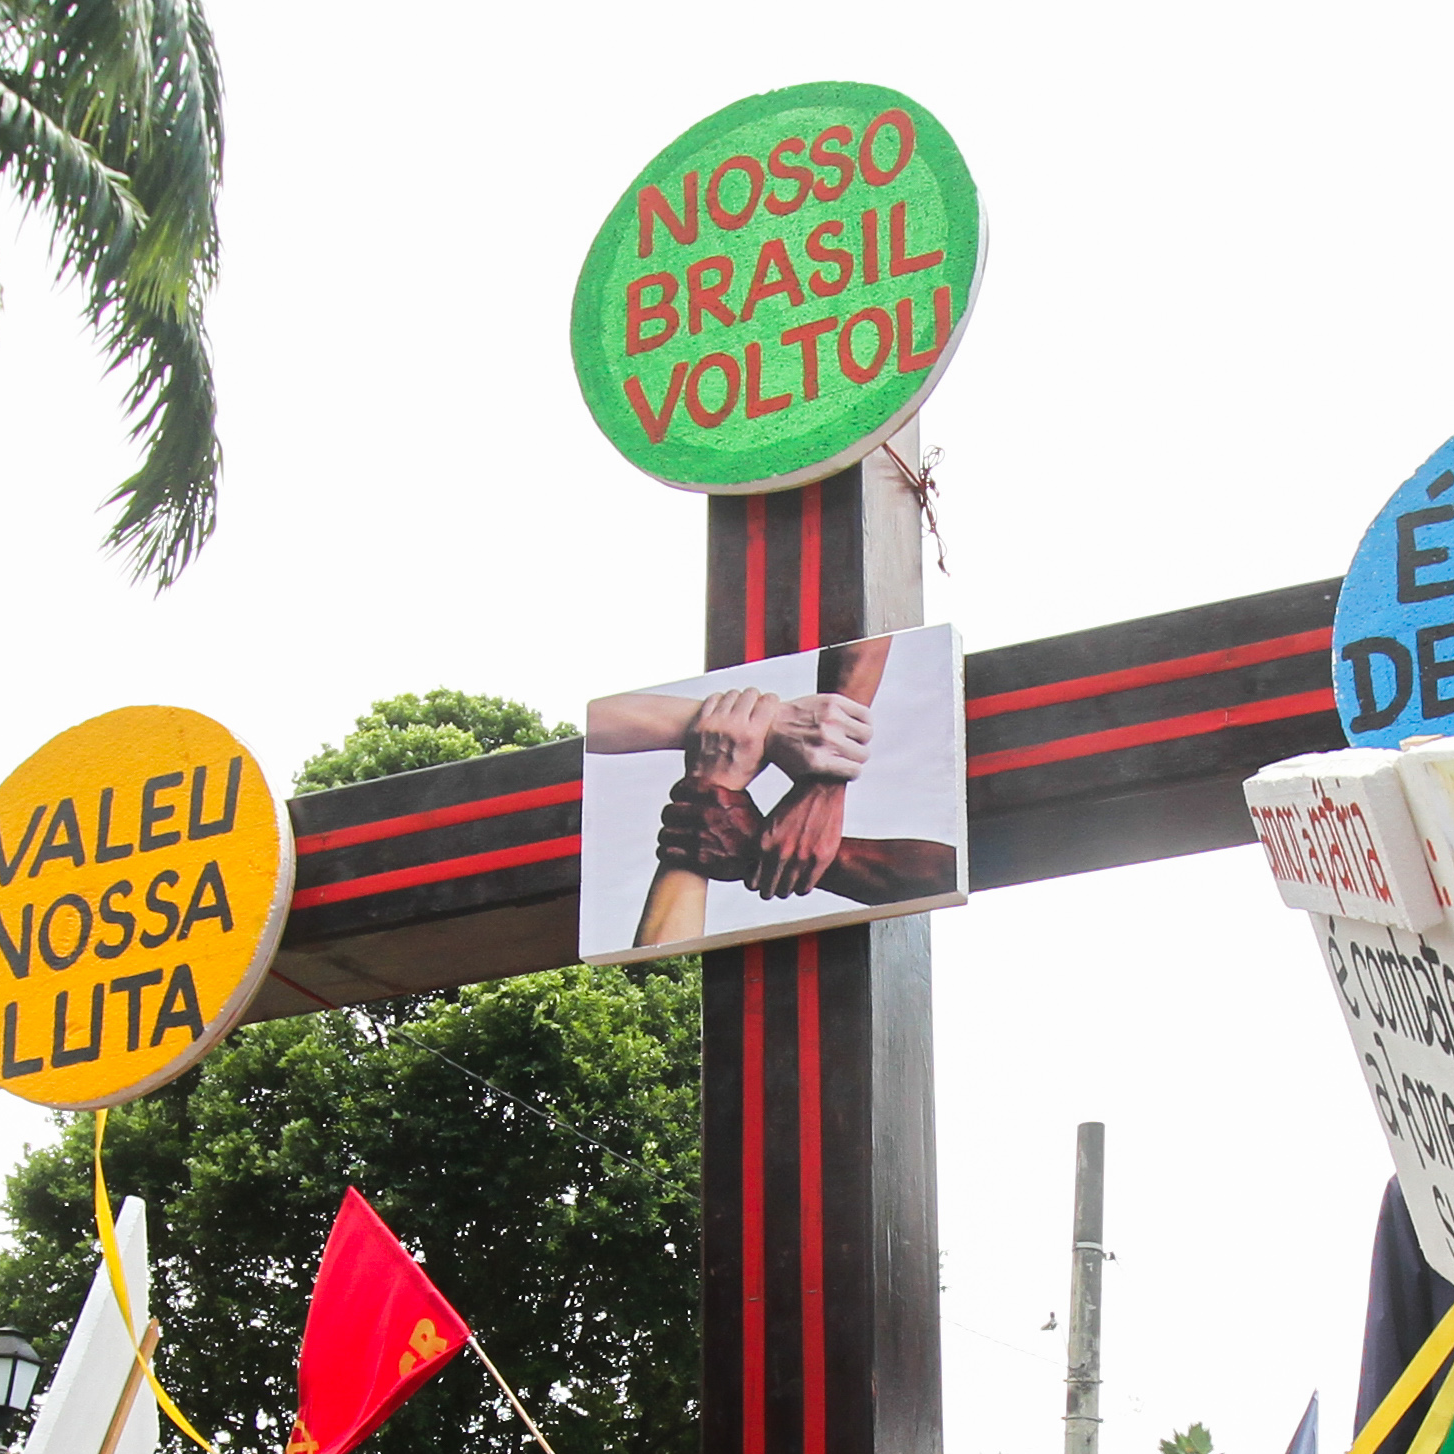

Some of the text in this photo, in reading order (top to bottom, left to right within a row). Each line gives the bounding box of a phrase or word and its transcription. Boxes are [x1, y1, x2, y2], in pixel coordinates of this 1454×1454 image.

[637, 107, 916, 259] NOSSO
[625, 200, 945, 357] BRASIL
[622, 285, 953, 445] VOLTOU
[1250, 802, 1312, 885] amor
[1, 963, 205, 1080] LUTA
